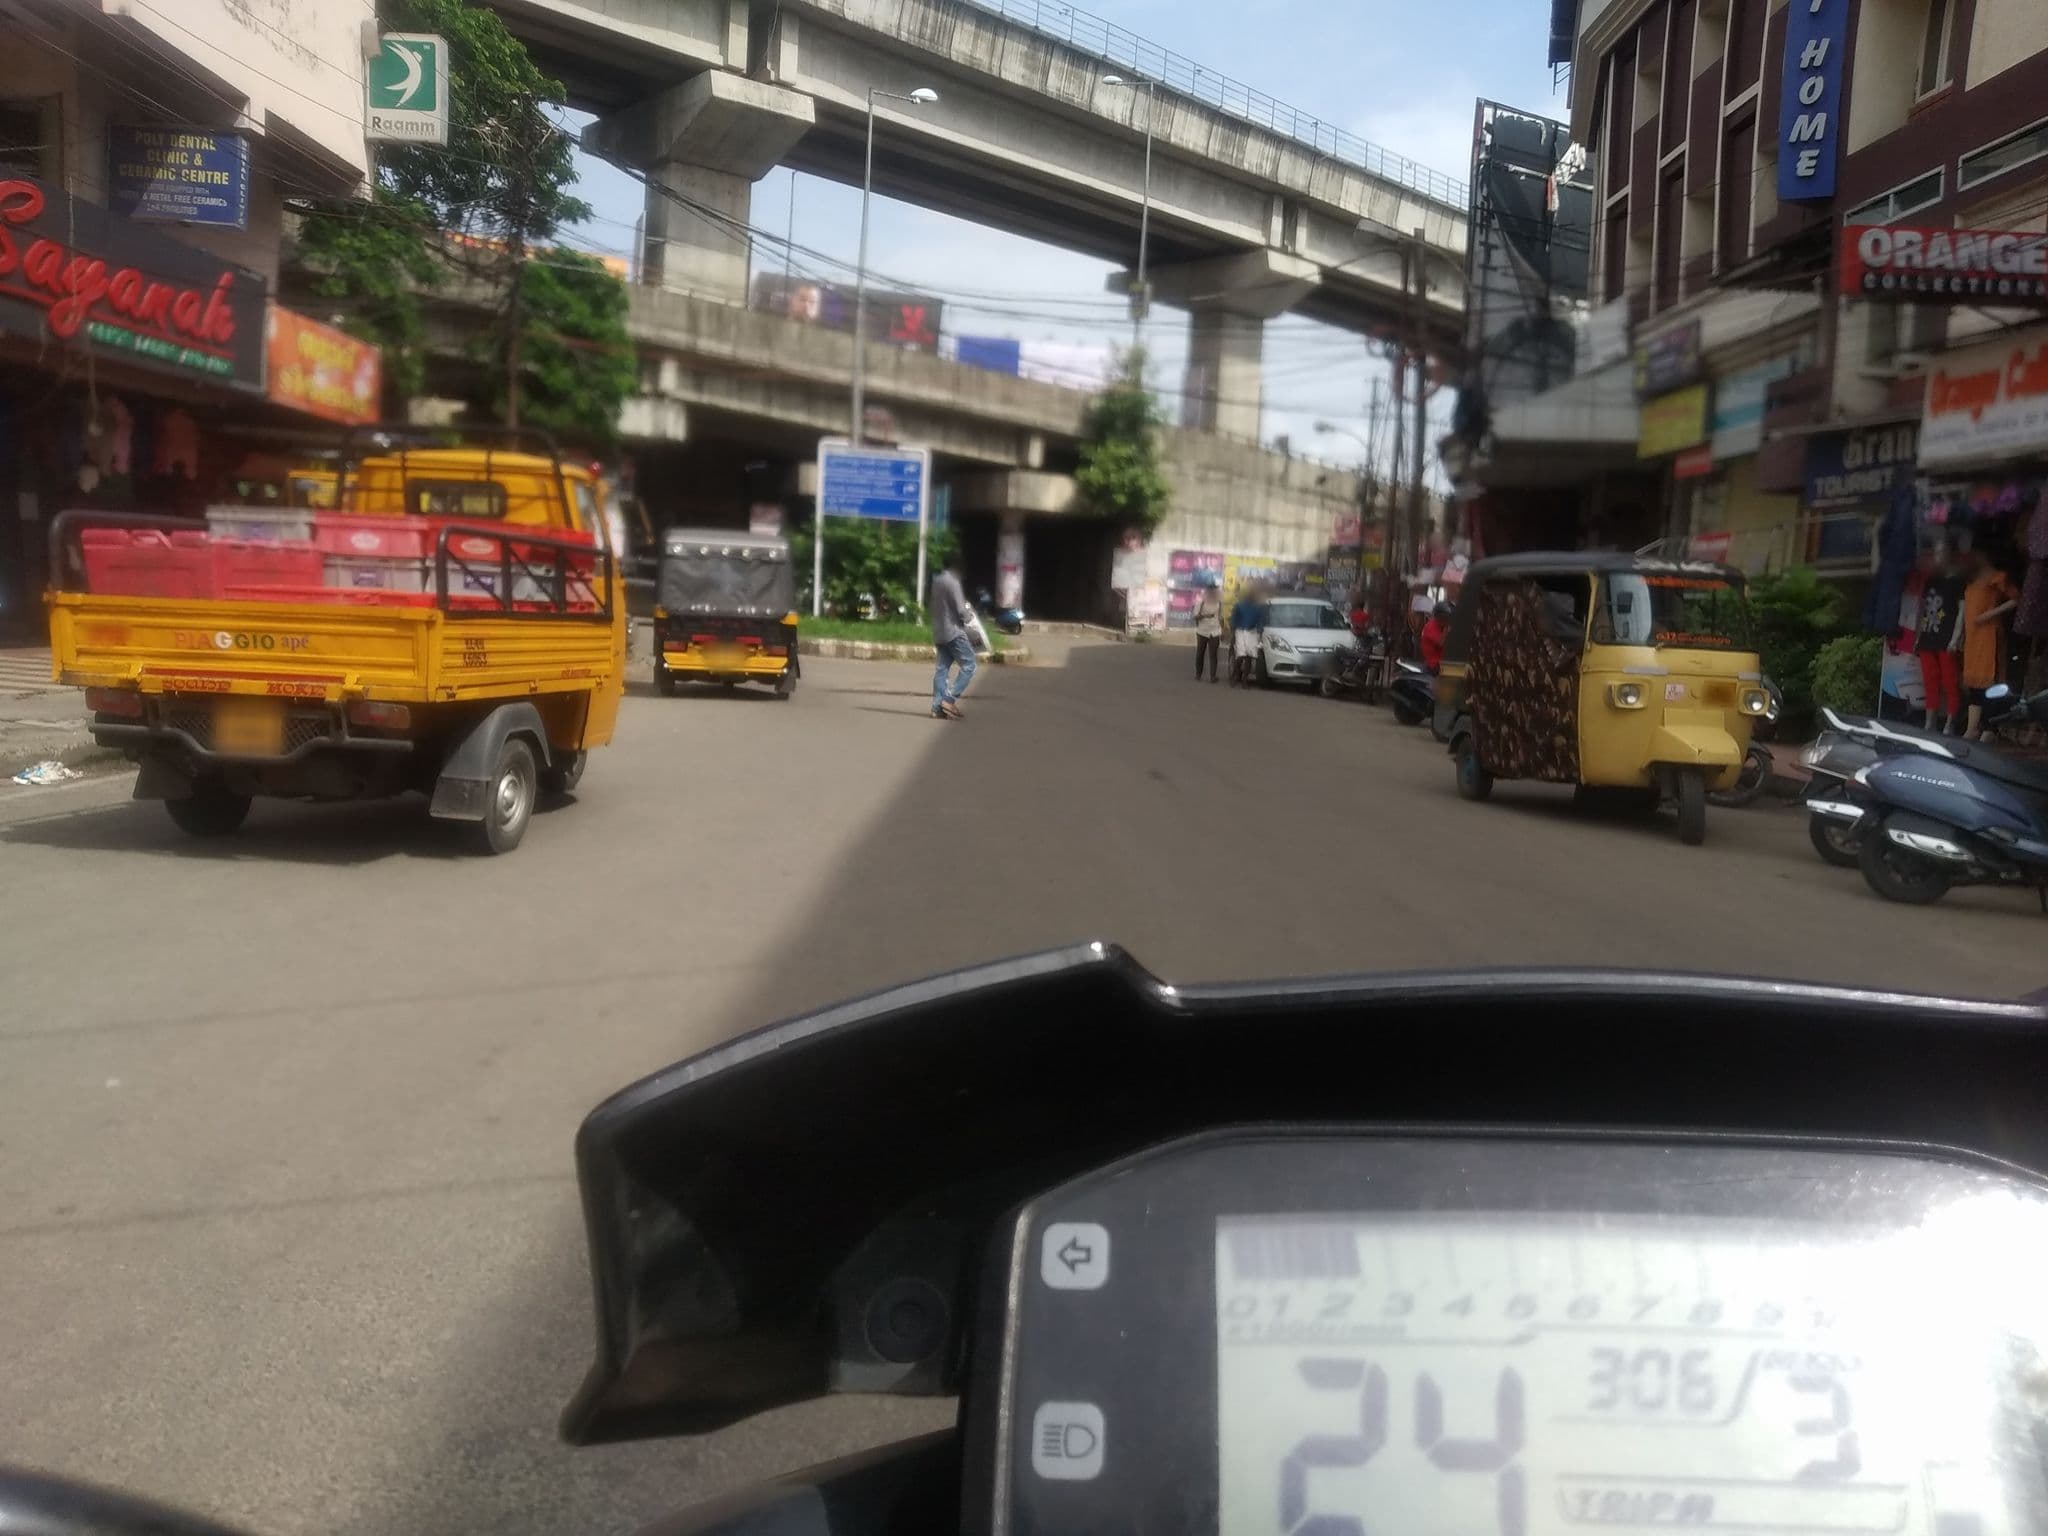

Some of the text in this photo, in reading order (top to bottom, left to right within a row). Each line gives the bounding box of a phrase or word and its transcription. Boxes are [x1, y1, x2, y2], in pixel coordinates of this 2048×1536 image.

[1789, 38, 1830, 177] HOME
[372, 116, 435, 132] Raamm
[171, 135, 216, 151] DENTAL
[147, 149, 203, 166] CLINIC &
[181, 168, 229, 185] CENTRE
[174, 195, 191, 204] FREE
[1858, 228, 2048, 275] ORANGE
[175, 631, 275, 649] PIAGGIO
[1278, 1356, 1527, 1536] 24
[1786, 1375, 1862, 1482] 3
